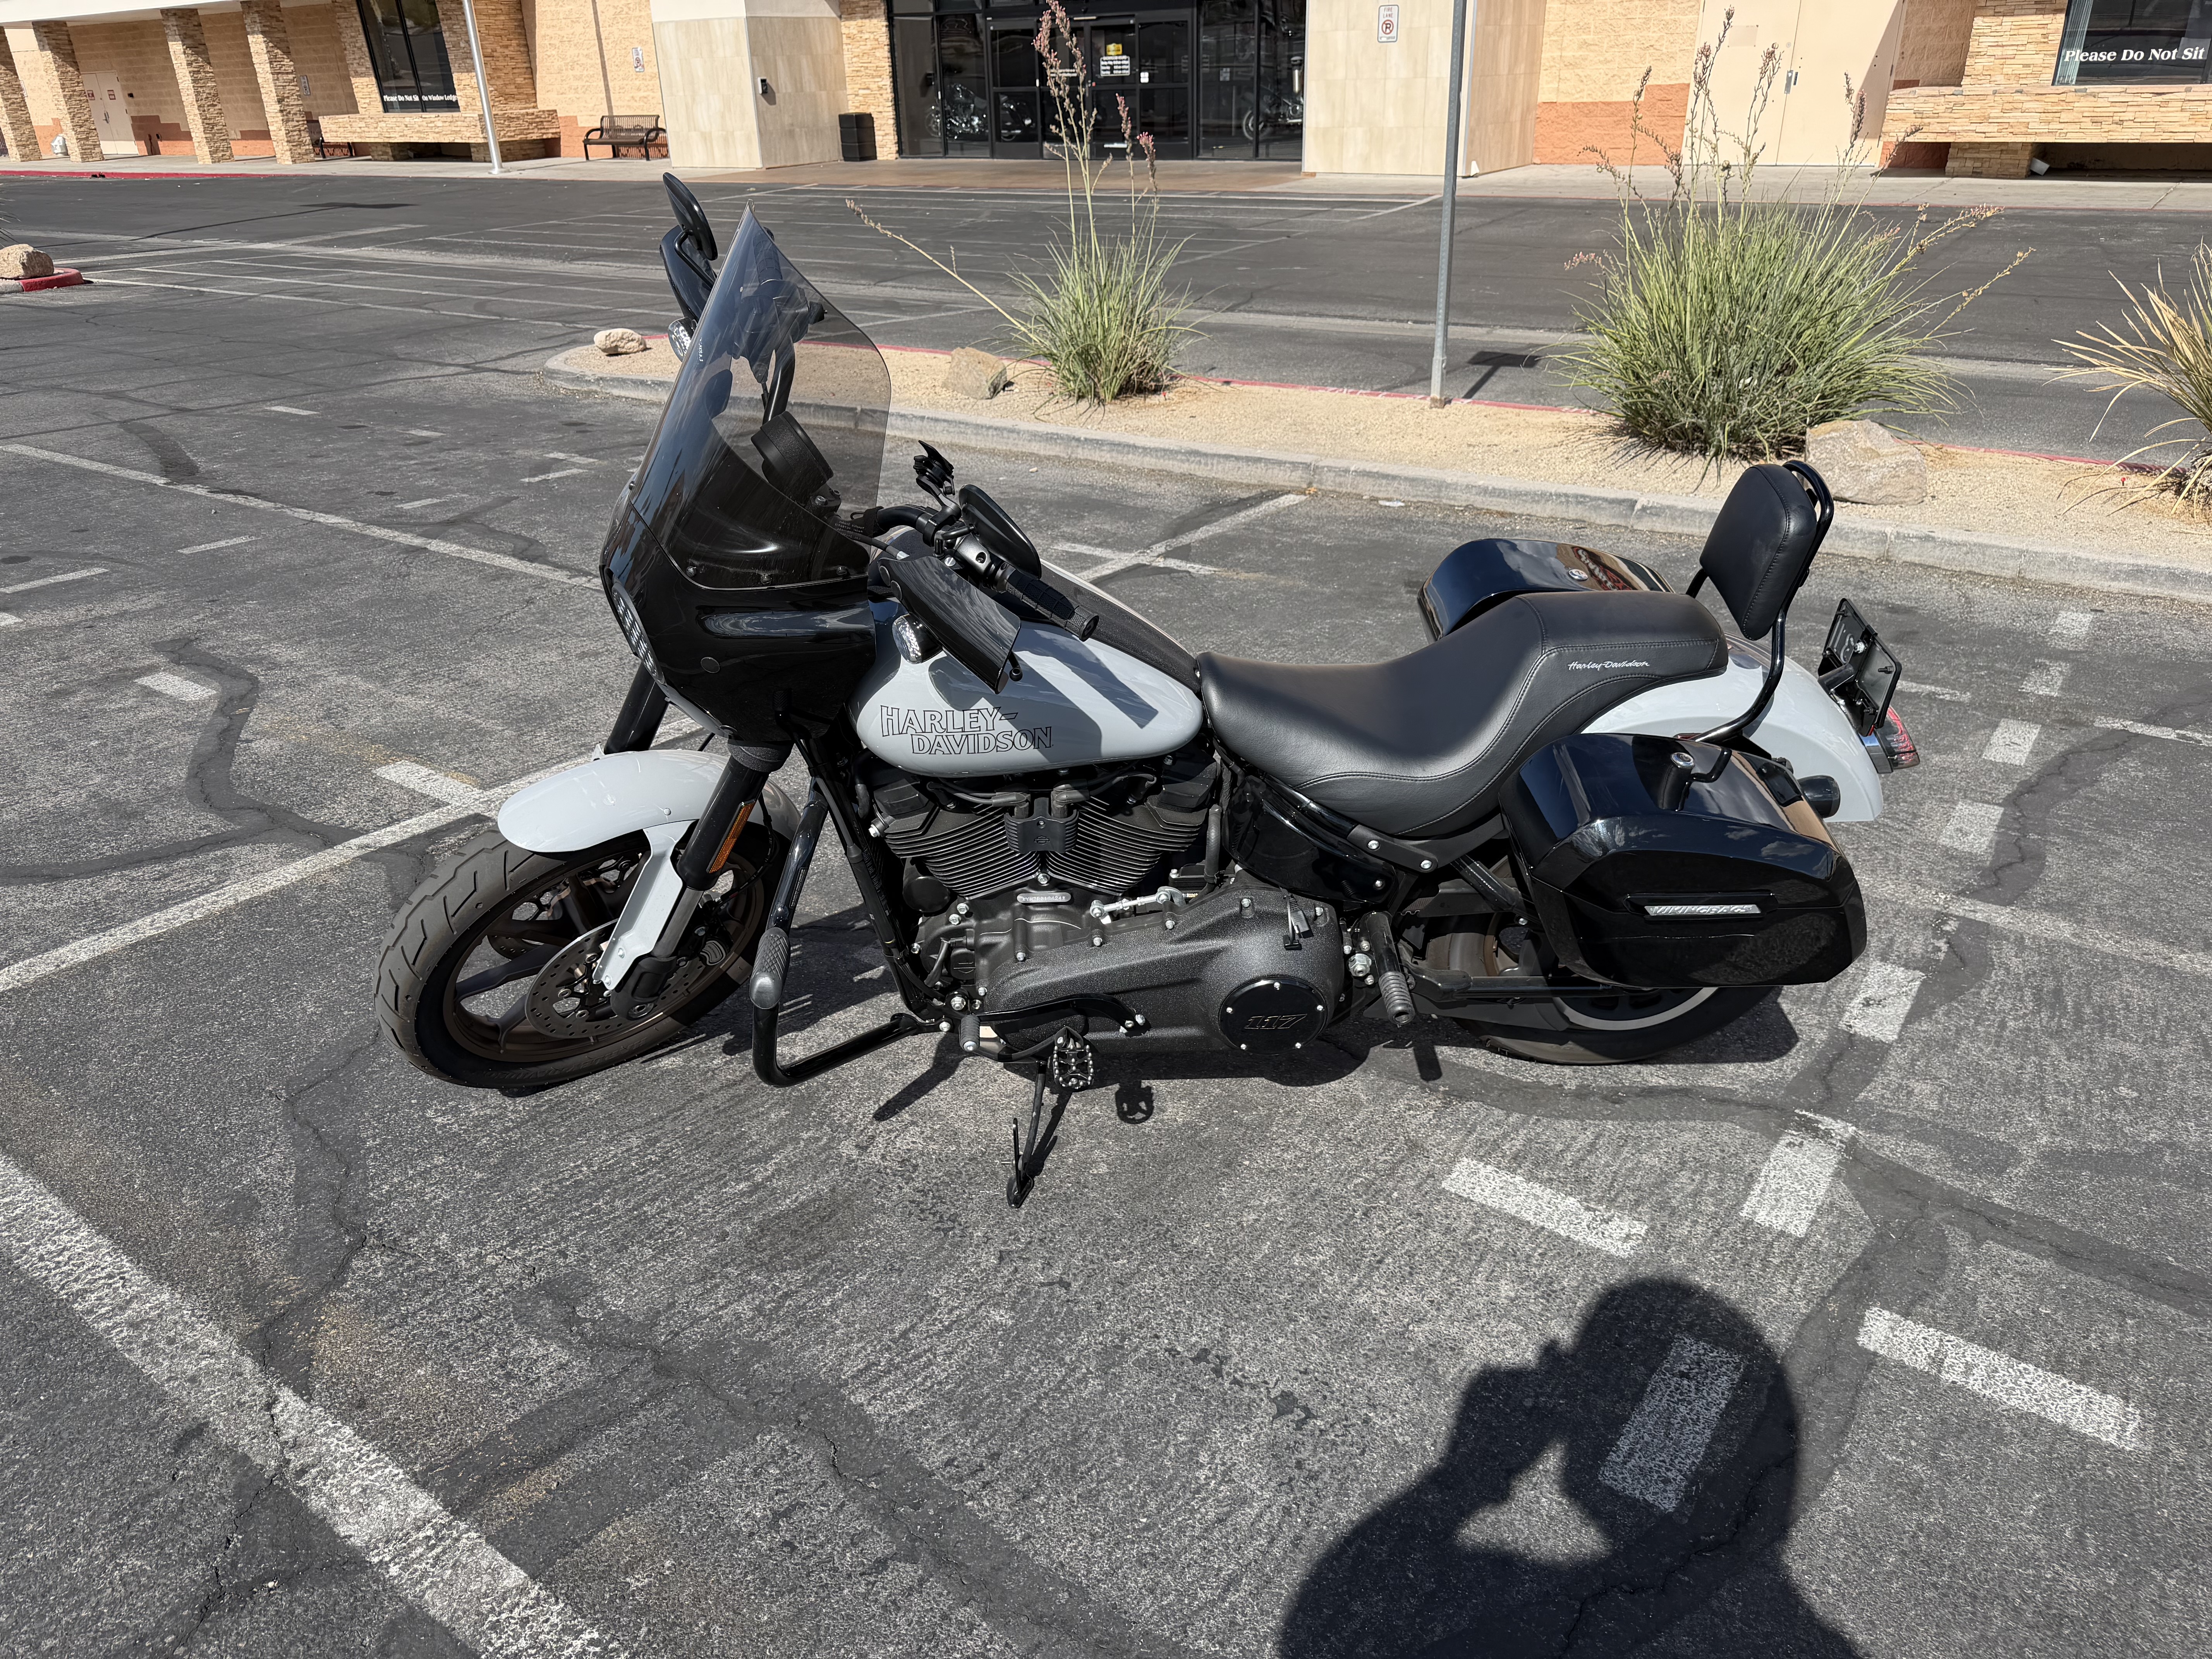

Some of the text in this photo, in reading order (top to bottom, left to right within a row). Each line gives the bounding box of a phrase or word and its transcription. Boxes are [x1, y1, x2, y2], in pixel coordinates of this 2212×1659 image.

[2064, 46, 2205, 62] Please Do Not Sit
[1568, 660, 1650, 671] Harley-Davidson
[910, 726, 1052, 754] DAVIDSON
[1244, 1014, 1307, 1029] 117
